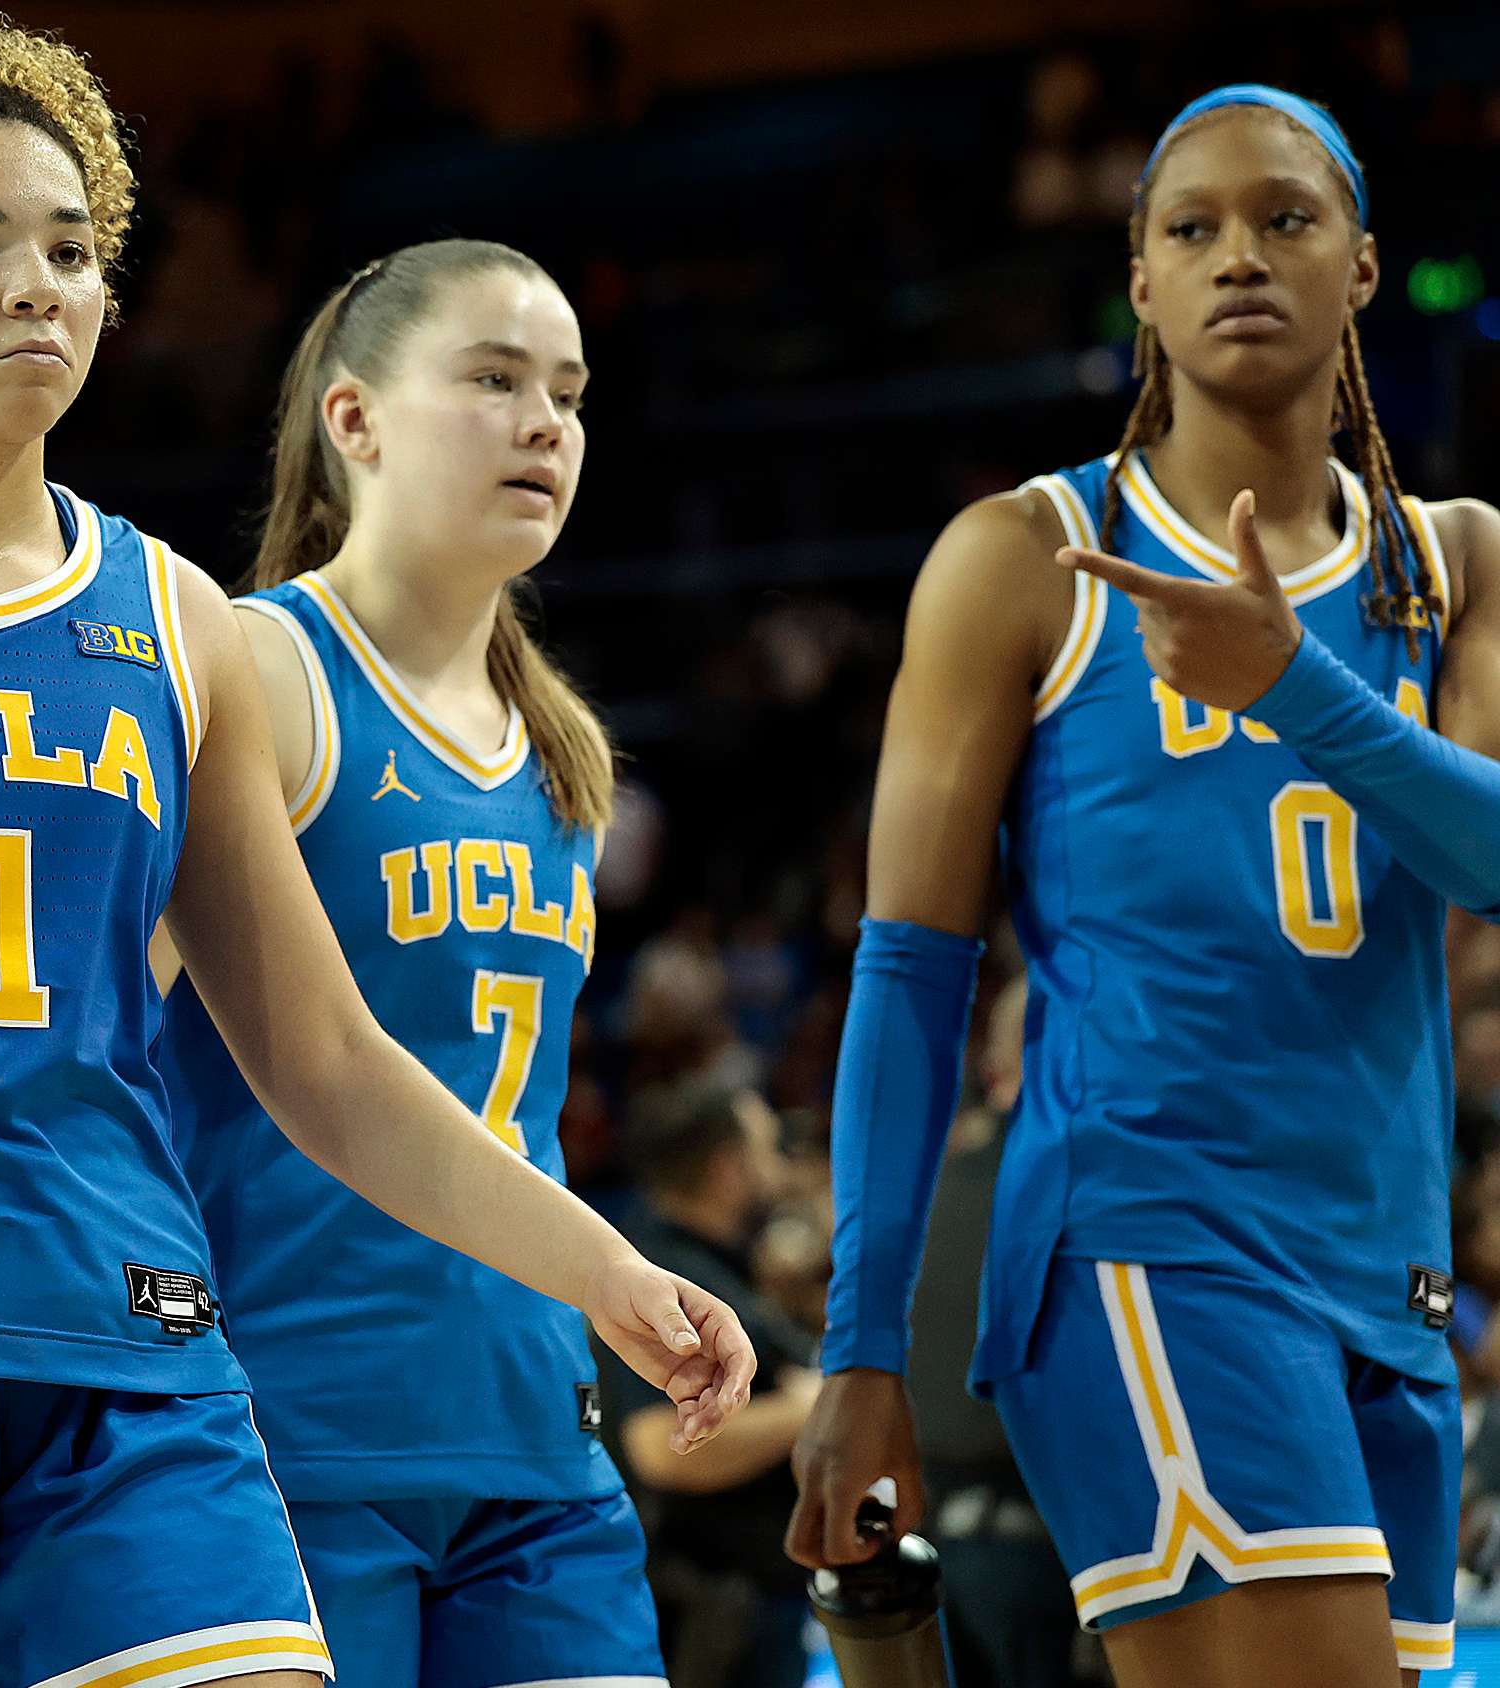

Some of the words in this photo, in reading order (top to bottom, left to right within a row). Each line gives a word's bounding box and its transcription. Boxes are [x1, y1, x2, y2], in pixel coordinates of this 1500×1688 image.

[380, 838, 597, 976] UCLA
[1269, 780, 1365, 959] 0
[471, 968, 544, 1157] 7
[197, 1290, 210, 1311] 42
